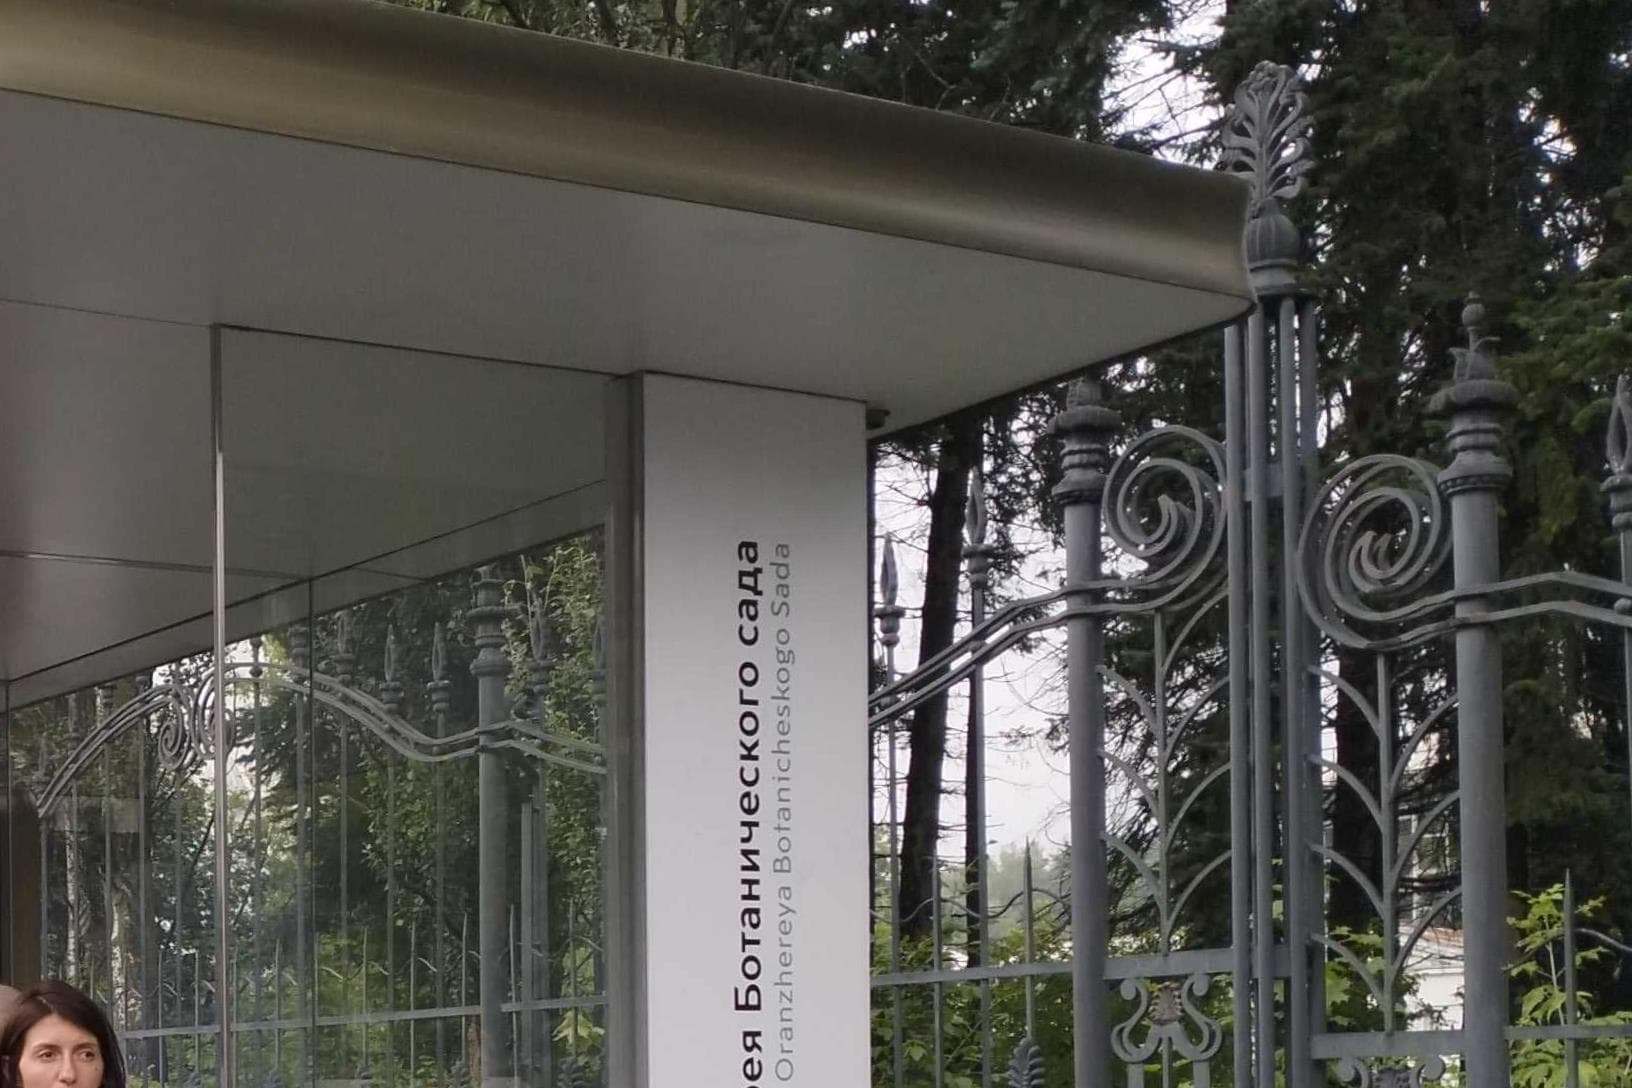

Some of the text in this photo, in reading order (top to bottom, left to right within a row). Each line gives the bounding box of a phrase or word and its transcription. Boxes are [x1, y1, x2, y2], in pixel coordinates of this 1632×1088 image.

[737, 540, 764, 646] сада
[734, 661, 763, 1012] Ботанического
[769, 542, 797, 1082] Oranzhereya Botanicheskogo Sada
